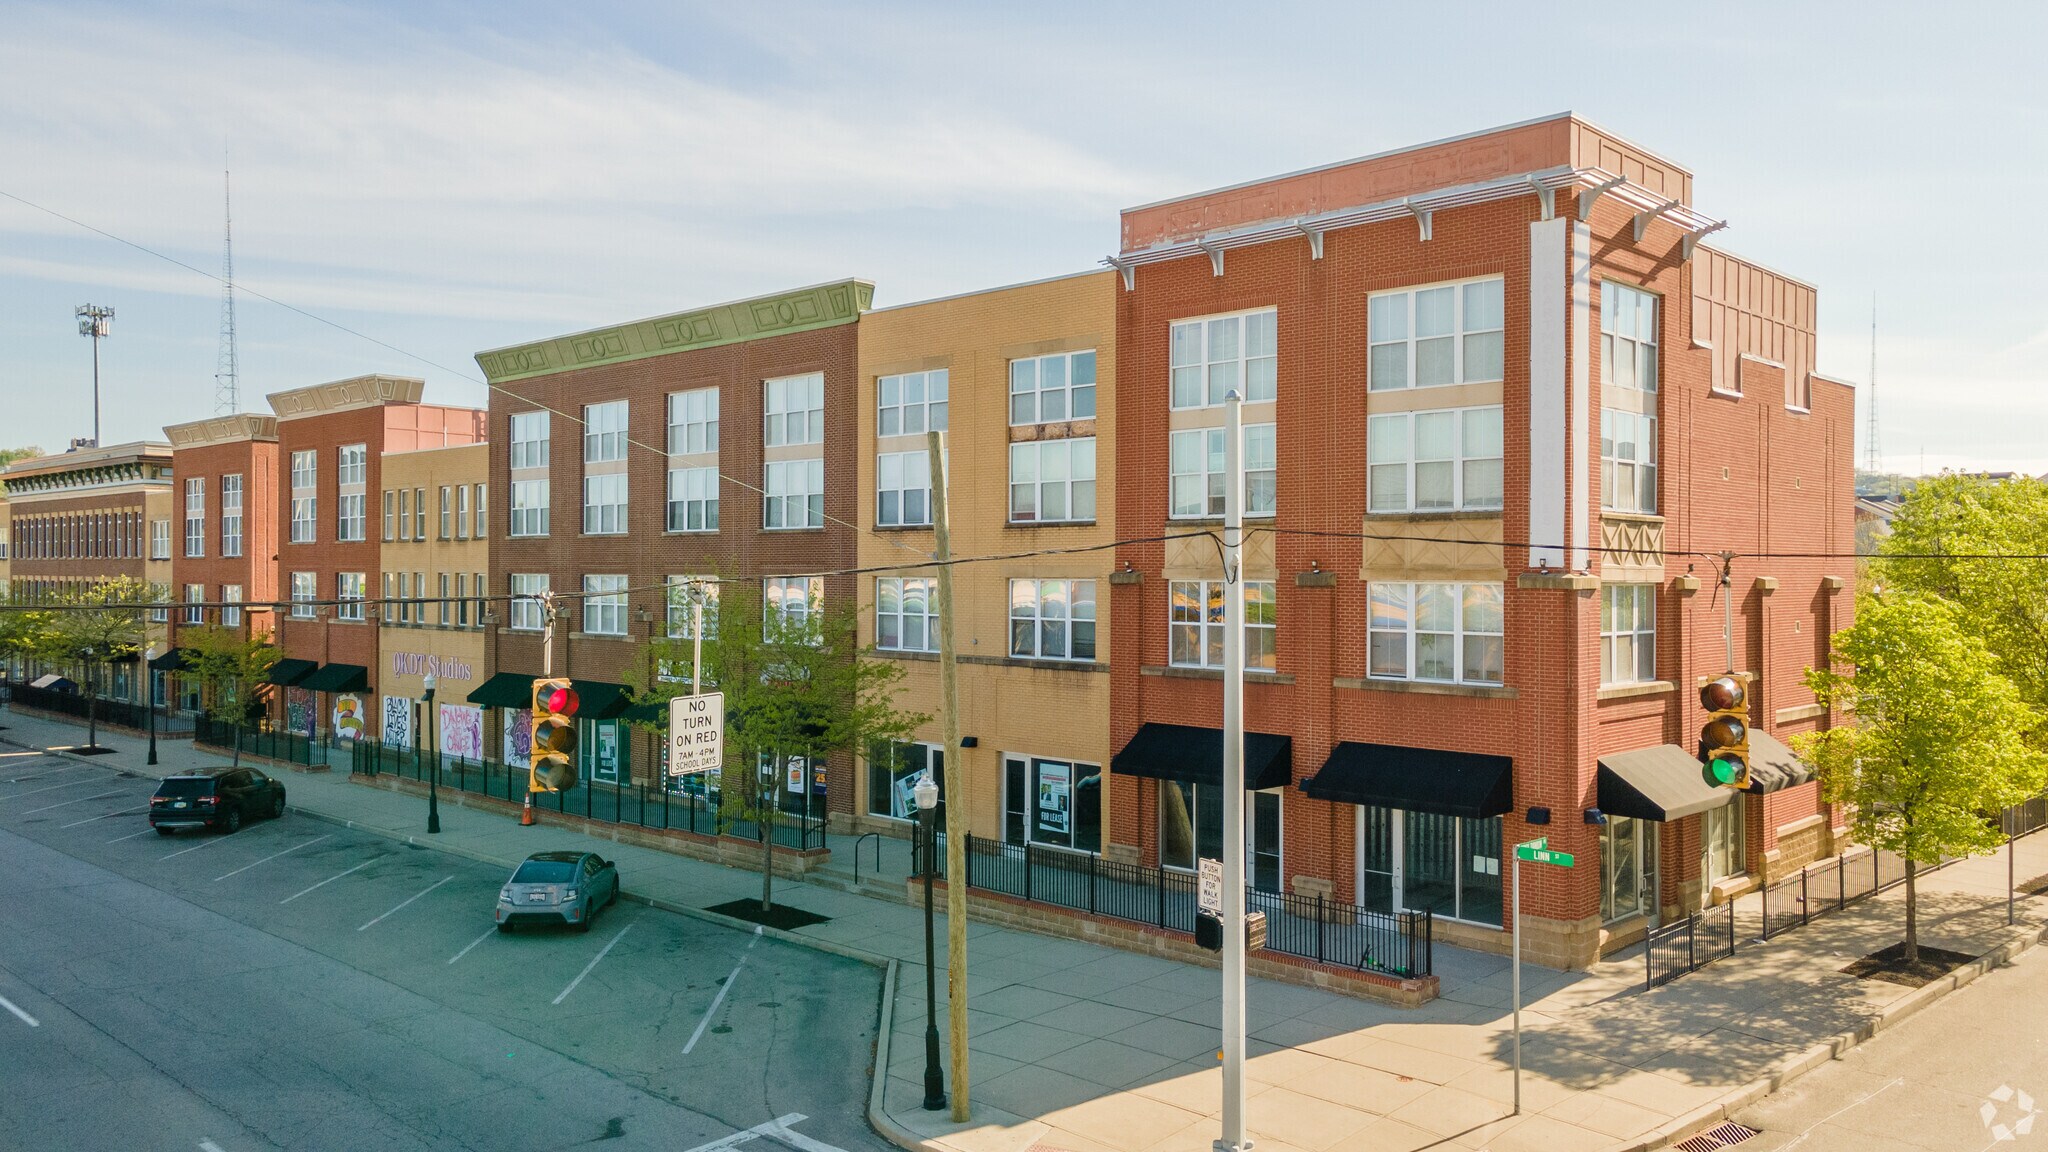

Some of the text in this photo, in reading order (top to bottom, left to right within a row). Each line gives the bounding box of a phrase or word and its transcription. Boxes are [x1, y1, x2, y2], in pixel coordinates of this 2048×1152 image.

[393, 652, 472, 681] QKDT Studios
[689, 700, 706, 713] NO
[683, 715, 712, 730] TURN
[676, 730, 717, 747] ON RED
[679, 750, 694, 760] 7AM
[699, 747, 715, 757] 4PM
[675, 756, 716, 771] SCHOOL DAYS
[1041, 811, 1063, 824] FOR LEASE
[1533, 850, 1550, 862] LINN
[1204, 864, 1218, 873] PUSH
[1201, 871, 1221, 883] BUTTON
[1205, 881, 1216, 890] FOR
[1203, 889, 1218, 899] WALK
[1203, 897, 1218, 907] LIGHT
